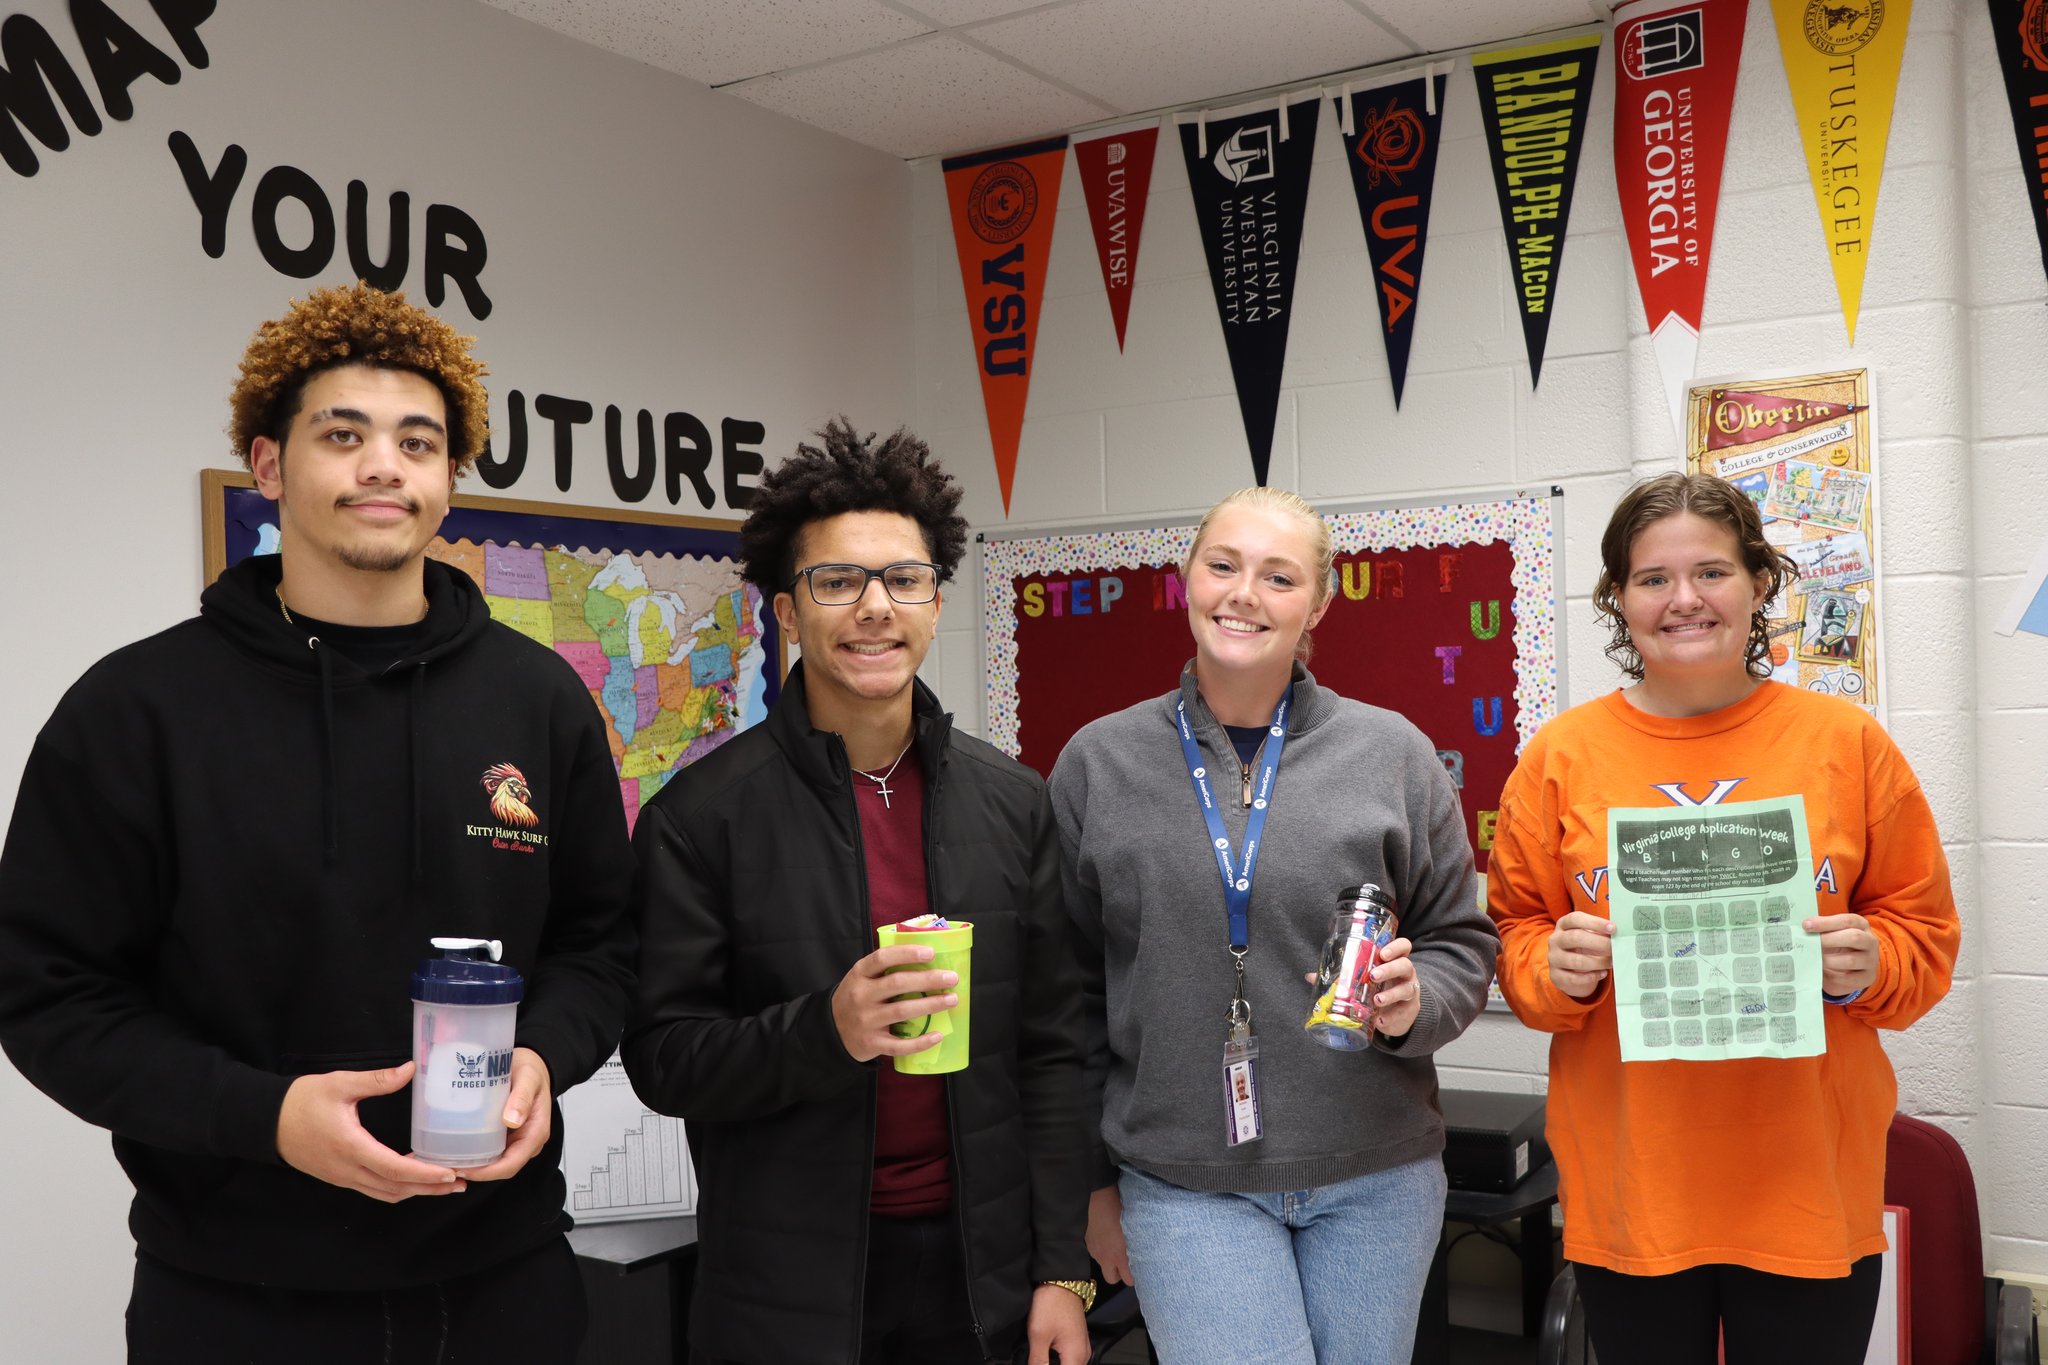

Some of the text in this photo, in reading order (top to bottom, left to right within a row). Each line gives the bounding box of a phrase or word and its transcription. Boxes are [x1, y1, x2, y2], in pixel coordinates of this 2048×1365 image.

[1643, 90, 1680, 278] GEORGIA
[1676, 87, 1699, 267] UNIVERSITY OF
[1819, 121, 1832, 198] UNIVERSITY
[1828, 54, 1863, 257] TUSKEGEE
[1492, 61, 1578, 314] RANDOLPH-MACON
[168, 130, 492, 321] YOUR
[1261, 191, 1282, 320] VIRGINIA
[1220, 200, 1240, 325] UNIVERSITY
[1239, 195, 1261, 323] WESLEYAN
[1371, 195, 1419, 332] UVA
[982, 242, 1027, 377] VSU
[1715, 400, 1831, 434] Oberlin
[476, 388, 766, 511] UTURE
[1721, 455, 1763, 473] COLLEGE
[1777, 427, 1848, 456] CONSERVATORY
[1023, 576, 1124, 618] STEP
[1799, 561, 1862, 580] CLEVELAND
[1199, 780, 1211, 809] AmeriCorps
[1259, 766, 1271, 798] AmeriCorps
[467, 825, 494, 837] KITTY
[495, 827, 520, 840] HAWK
[521, 831, 543, 844] SURF
[1242, 840, 1254, 877] AmeriCorps
[1622, 822, 1788, 854] Virginia College Application Week
[1222, 850, 1235, 888] AmeriCorps
[452, 1077, 509, 1088] FORGED BY THE
[488, 1051, 513, 1077] NAV
